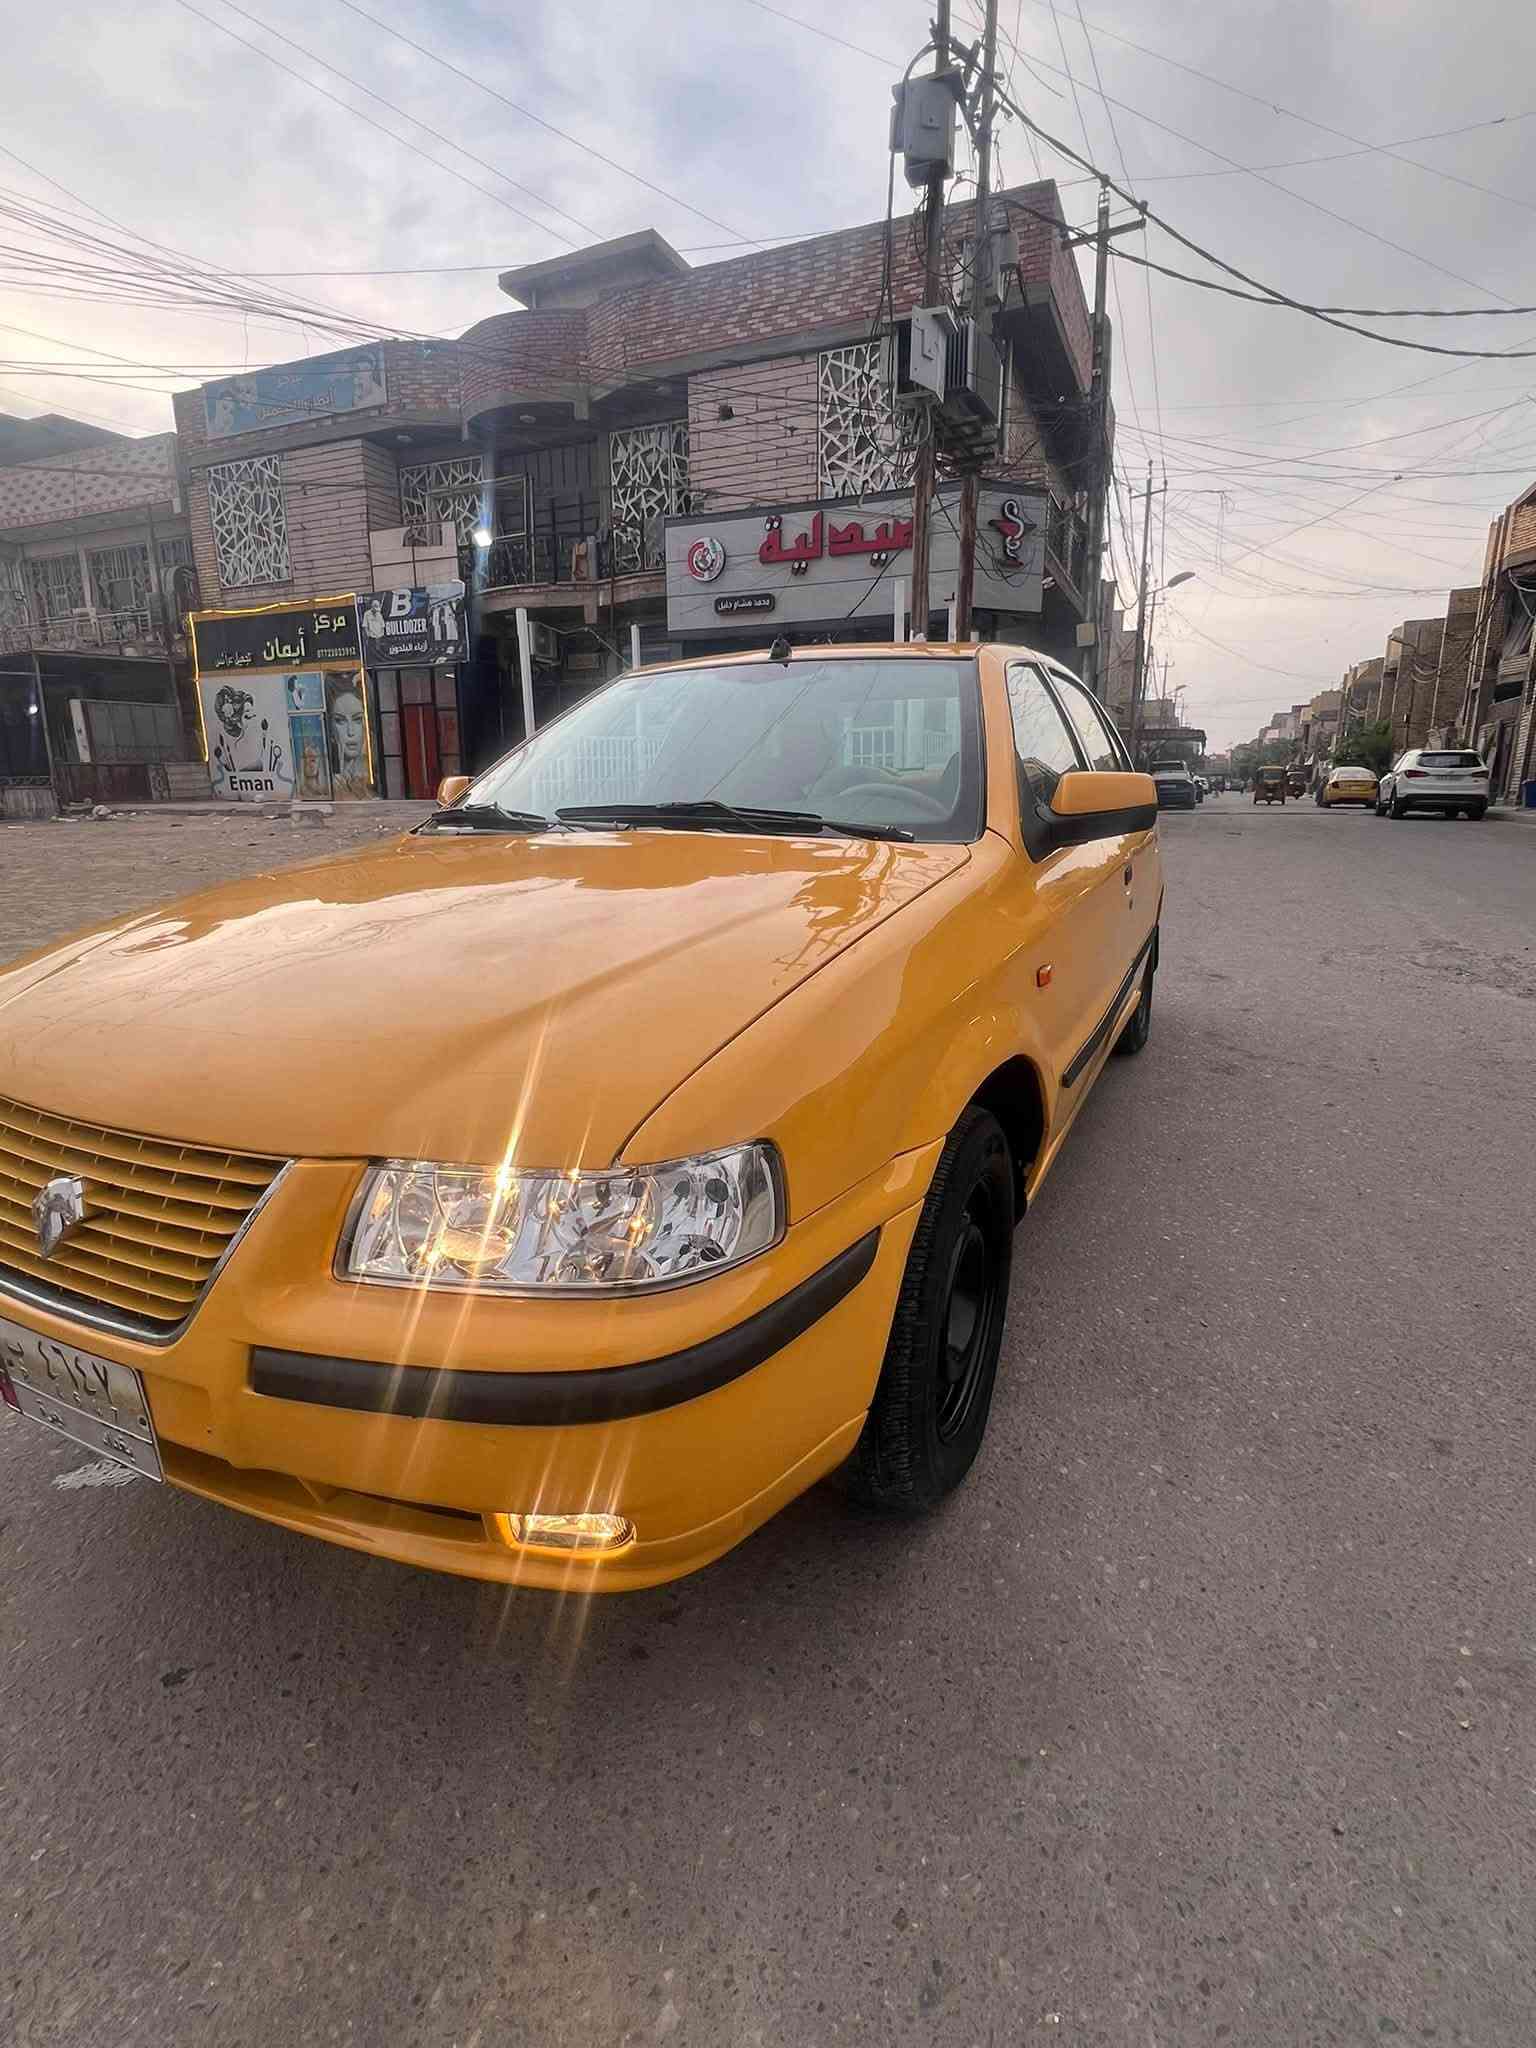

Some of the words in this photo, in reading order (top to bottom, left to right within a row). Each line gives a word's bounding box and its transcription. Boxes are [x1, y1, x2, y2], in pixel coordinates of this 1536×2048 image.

[758, 510, 913, 575] صيدلية
[312, 612, 347, 635] مركز
[385, 618, 428, 636] BULLDOZER
[263, 625, 306, 665] أيمان
[230, 775, 274, 792] Eman
